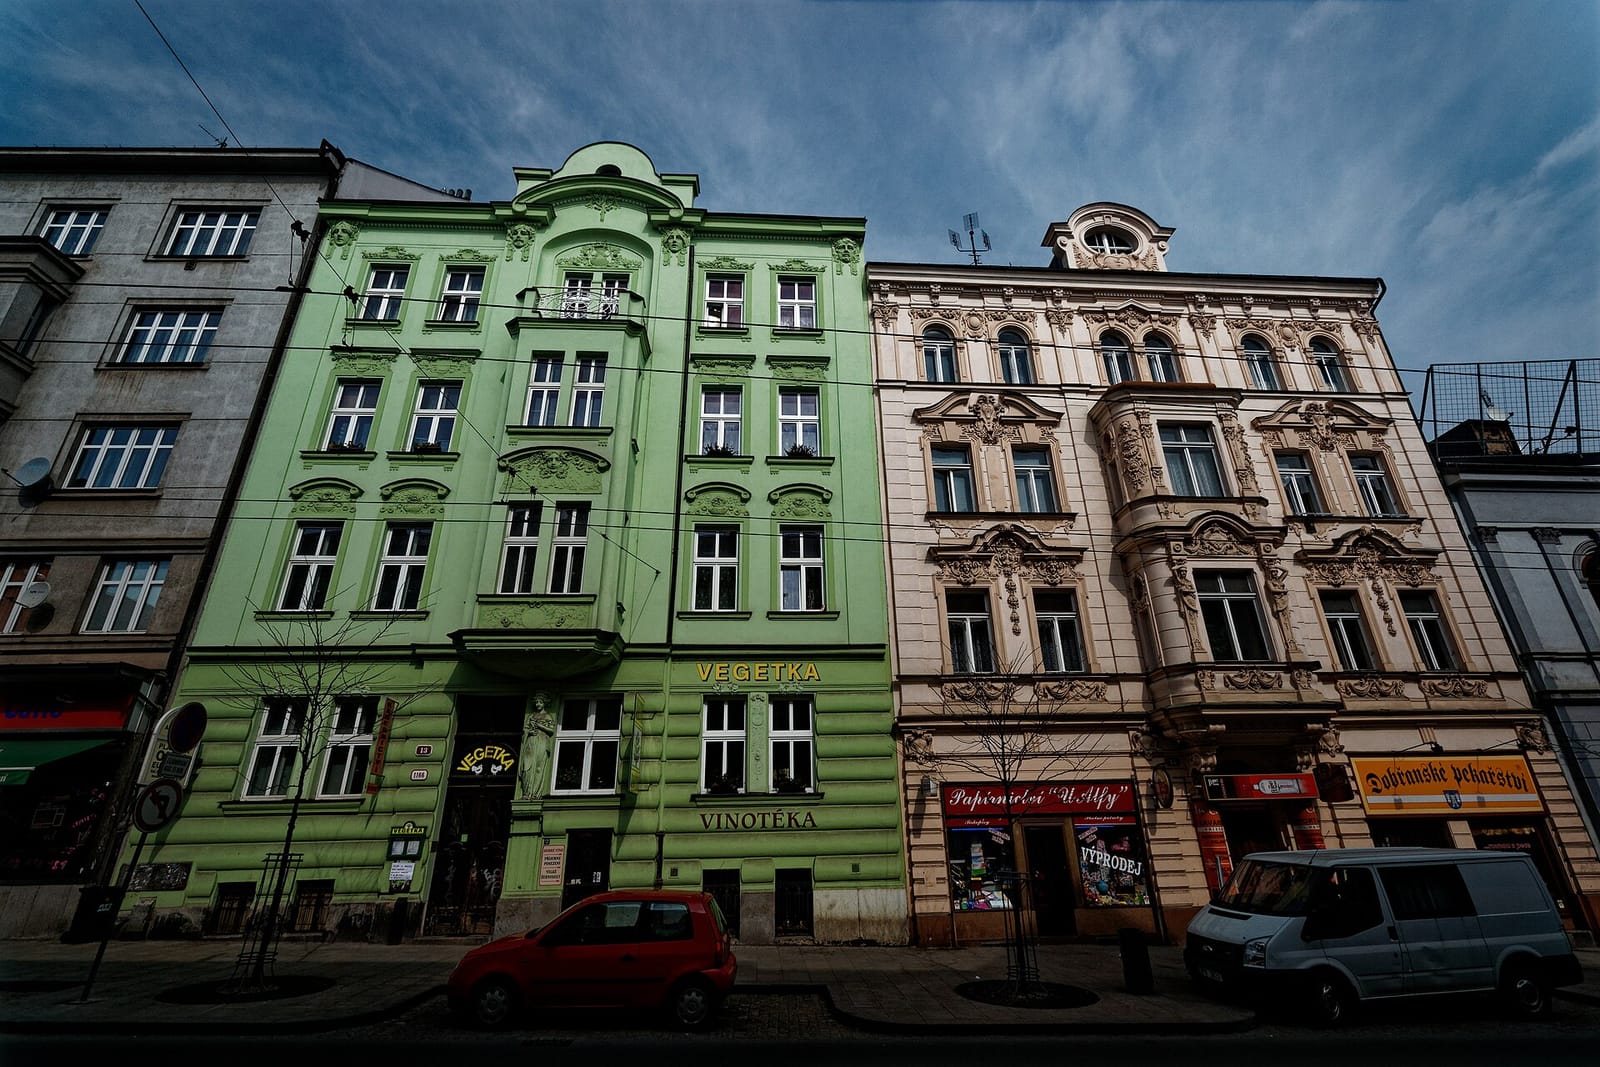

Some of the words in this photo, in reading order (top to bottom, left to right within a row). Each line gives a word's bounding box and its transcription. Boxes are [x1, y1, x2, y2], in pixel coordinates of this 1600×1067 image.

[696, 662, 822, 682] VEGETKA
[456, 745, 515, 772] VEGETKA
[700, 808, 817, 830] VINOTÉKA
[1080, 845, 1142, 876] VÝPRODEJ
